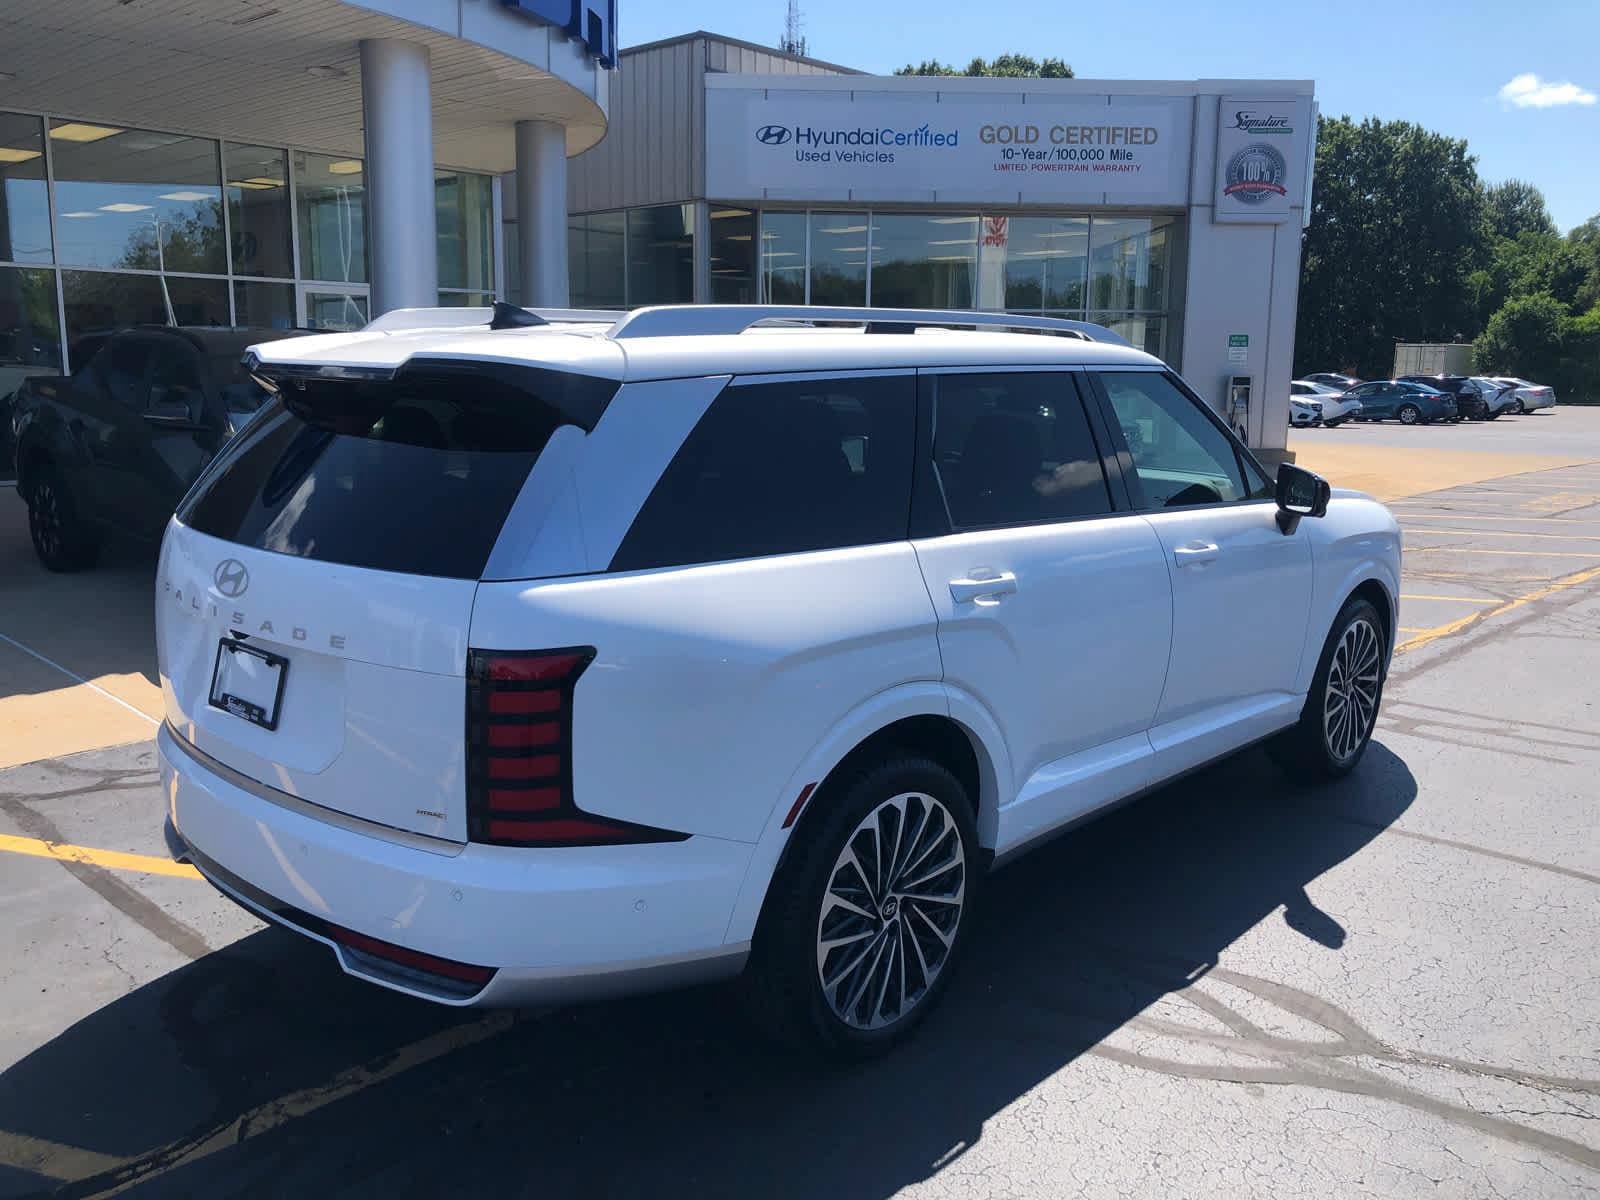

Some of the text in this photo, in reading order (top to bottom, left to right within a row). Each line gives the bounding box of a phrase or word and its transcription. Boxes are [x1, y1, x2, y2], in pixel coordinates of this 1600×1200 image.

[1224, 111, 1288, 131] Signature
[979, 125, 1158, 145] GOLD CERTIFIED
[795, 150, 895, 163] Used Vehicles
[1001, 147, 1133, 161] 10-Year/100,000 Mile
[993, 163, 1142, 173] LIMITED POWERTRAIN WARRANTY
[1242, 160, 1270, 181] 100%
